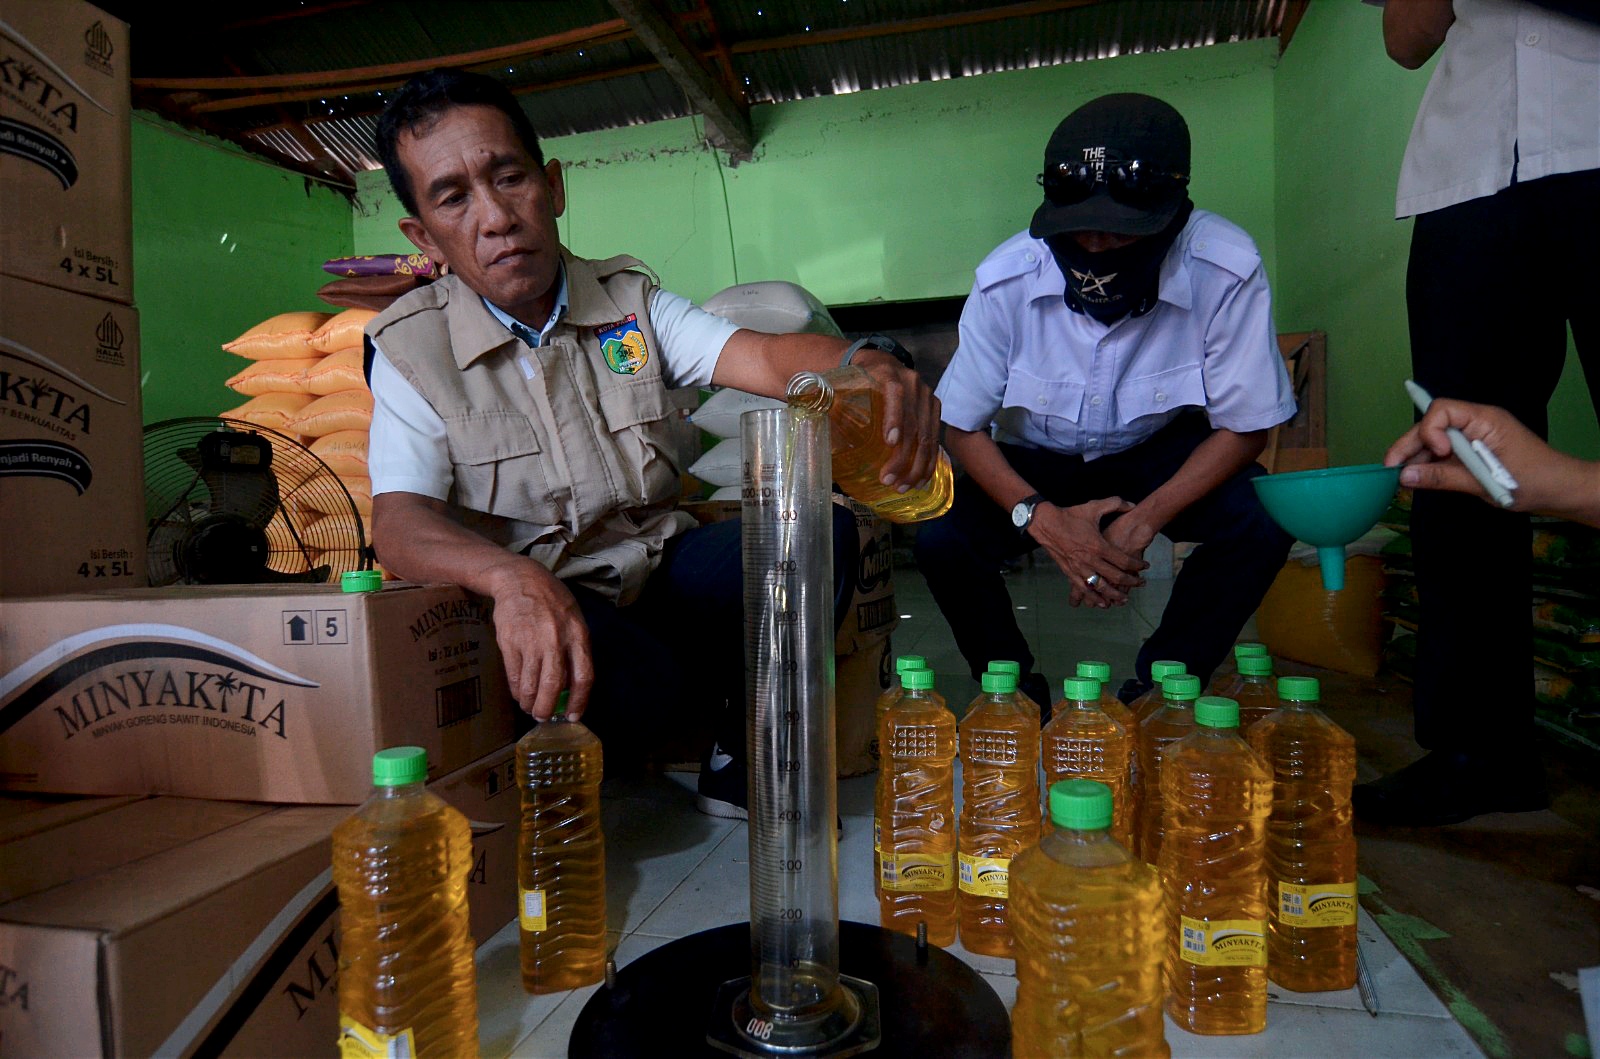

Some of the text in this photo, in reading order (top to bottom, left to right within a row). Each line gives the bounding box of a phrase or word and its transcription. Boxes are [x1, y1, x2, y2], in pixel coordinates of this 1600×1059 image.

[16, 134, 59, 160] Renyah
[1082, 146, 1106, 161] THE
[61, 257, 73, 273] 4
[96, 266, 119, 286] 5L
[96, 347, 125, 359] HALAL
[31, 452, 73, 469] Renyah
[78, 561, 134, 578] 4 x 5L
[774, 560, 797, 572] 900
[326, 616, 338, 637] 5
[54, 669, 288, 740] MINYAKITA
[92, 714, 257, 738] MINYAK GORENG SAWIT INDONESIA
[507, 763, 515, 782] 5
[779, 810, 801, 822] 400
[779, 860, 802, 871] 300
[904, 868, 945, 880] MINYAKITA
[780, 909, 802, 920] 200
[1311, 900, 1353, 914] MINYAKITA
[1215, 938, 1265, 952] MINYAKITA
